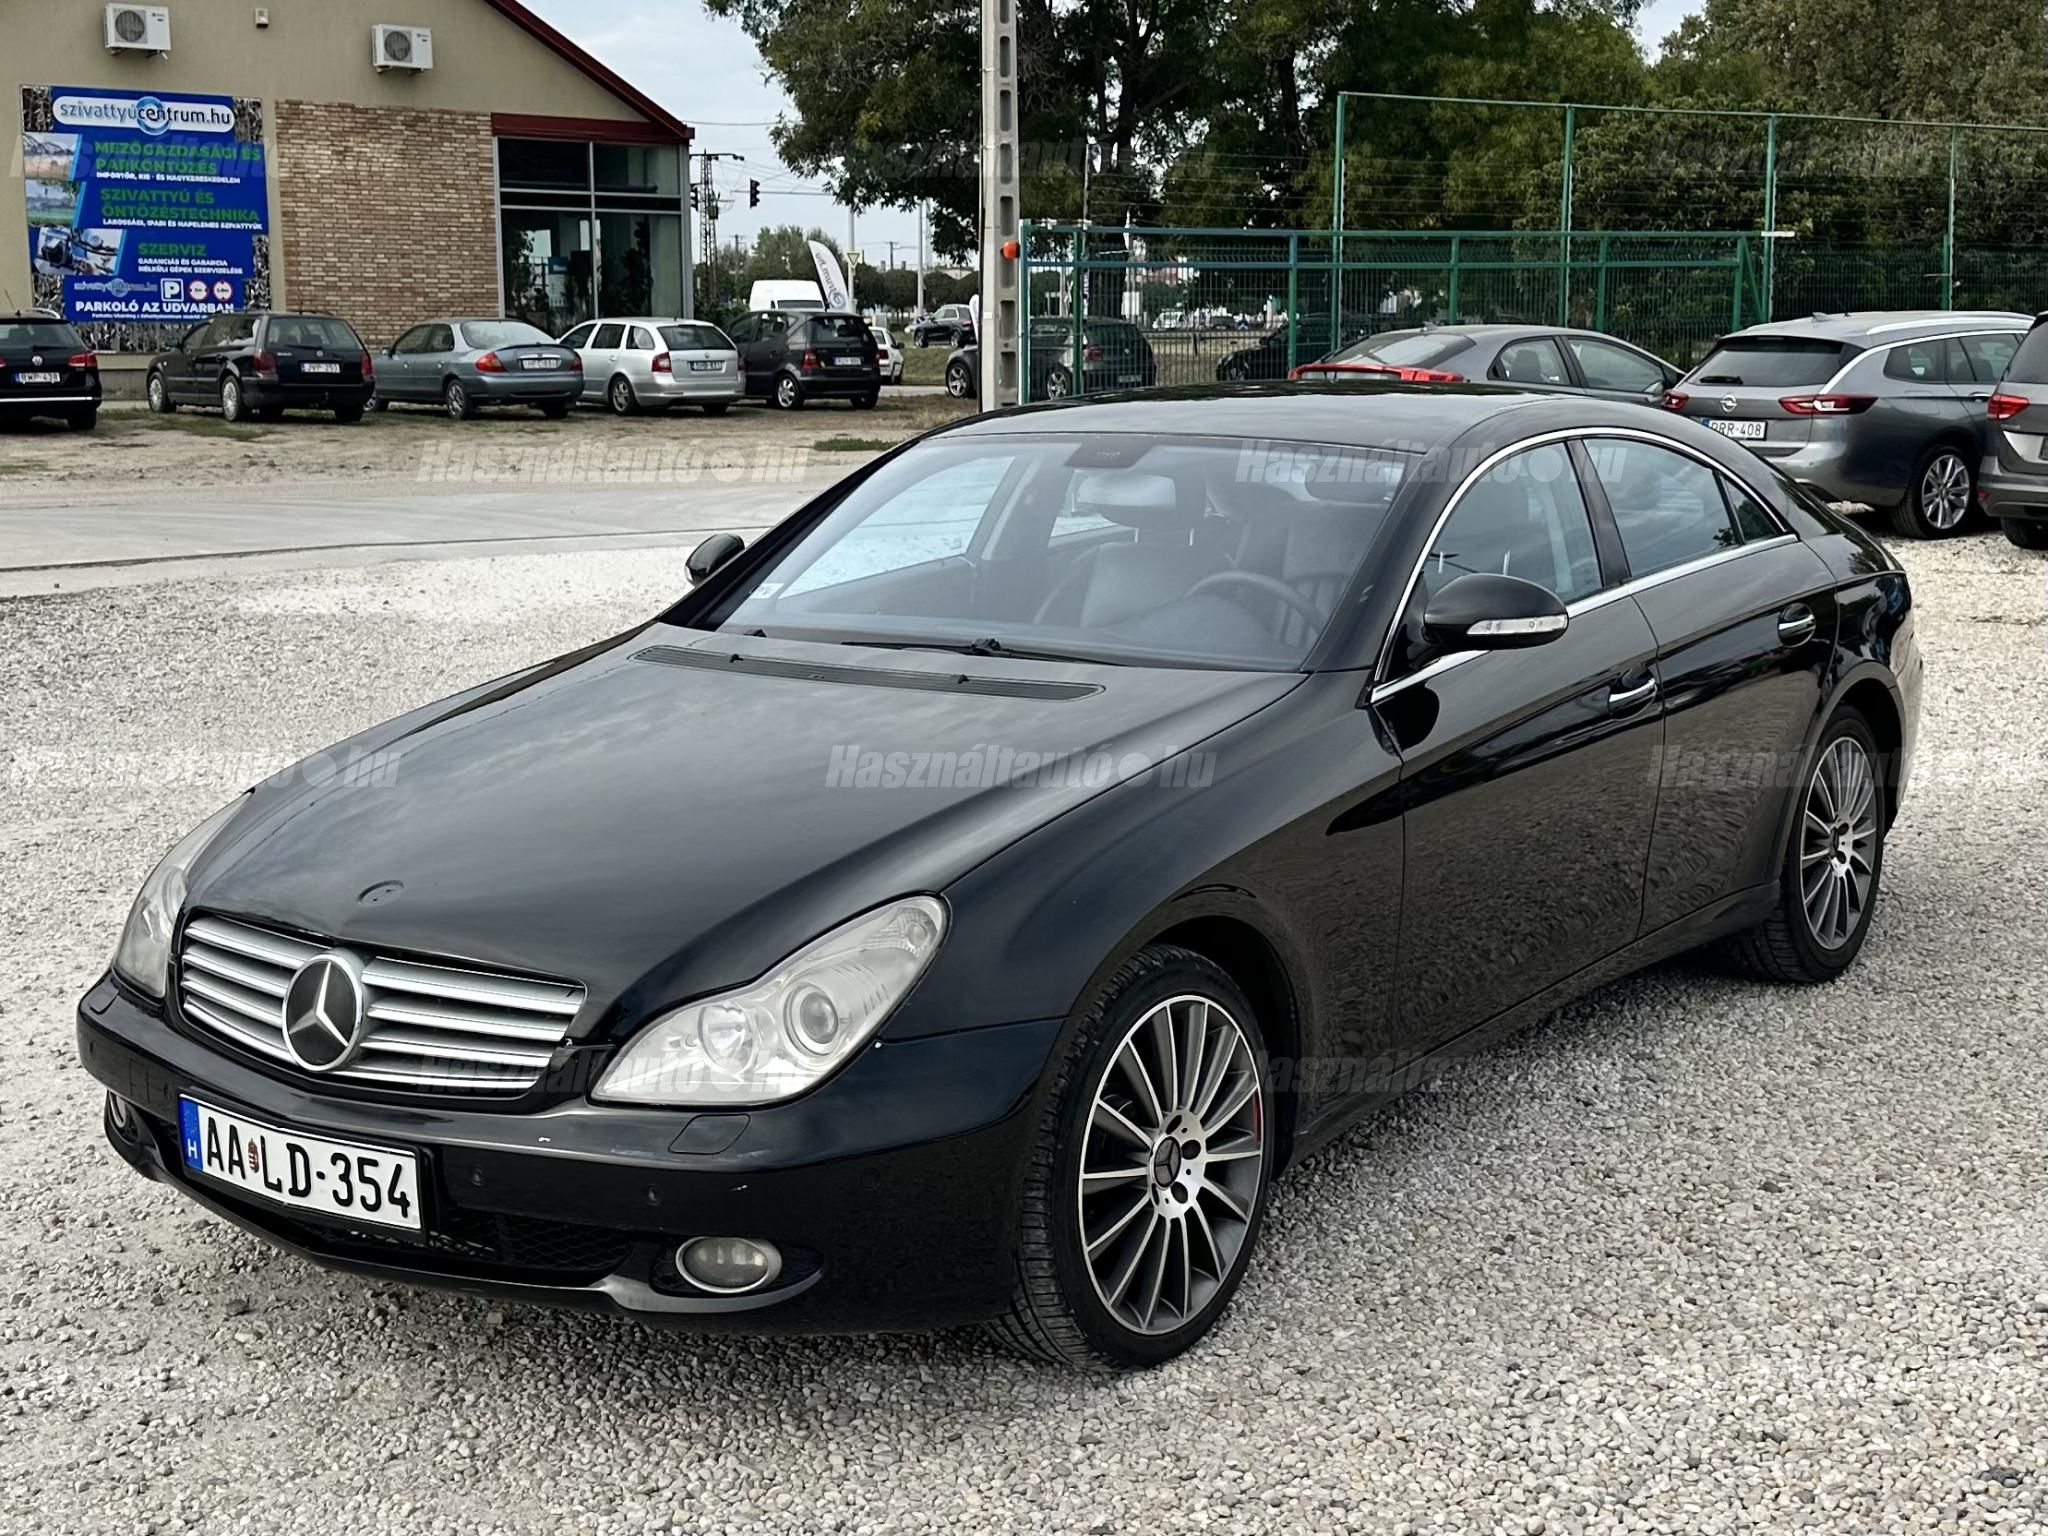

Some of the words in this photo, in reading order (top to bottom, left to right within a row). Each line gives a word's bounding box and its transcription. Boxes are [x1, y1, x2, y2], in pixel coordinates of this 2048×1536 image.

[60, 100, 231, 125] szivattyúcentrum.hu
[241, 144, 261, 161] ÉS
[195, 188, 215, 205] ÉS
[138, 242, 207, 257] SZERVIZ
[75, 299, 140, 312] PARKOLÓ
[141, 302, 161, 313] AZ
